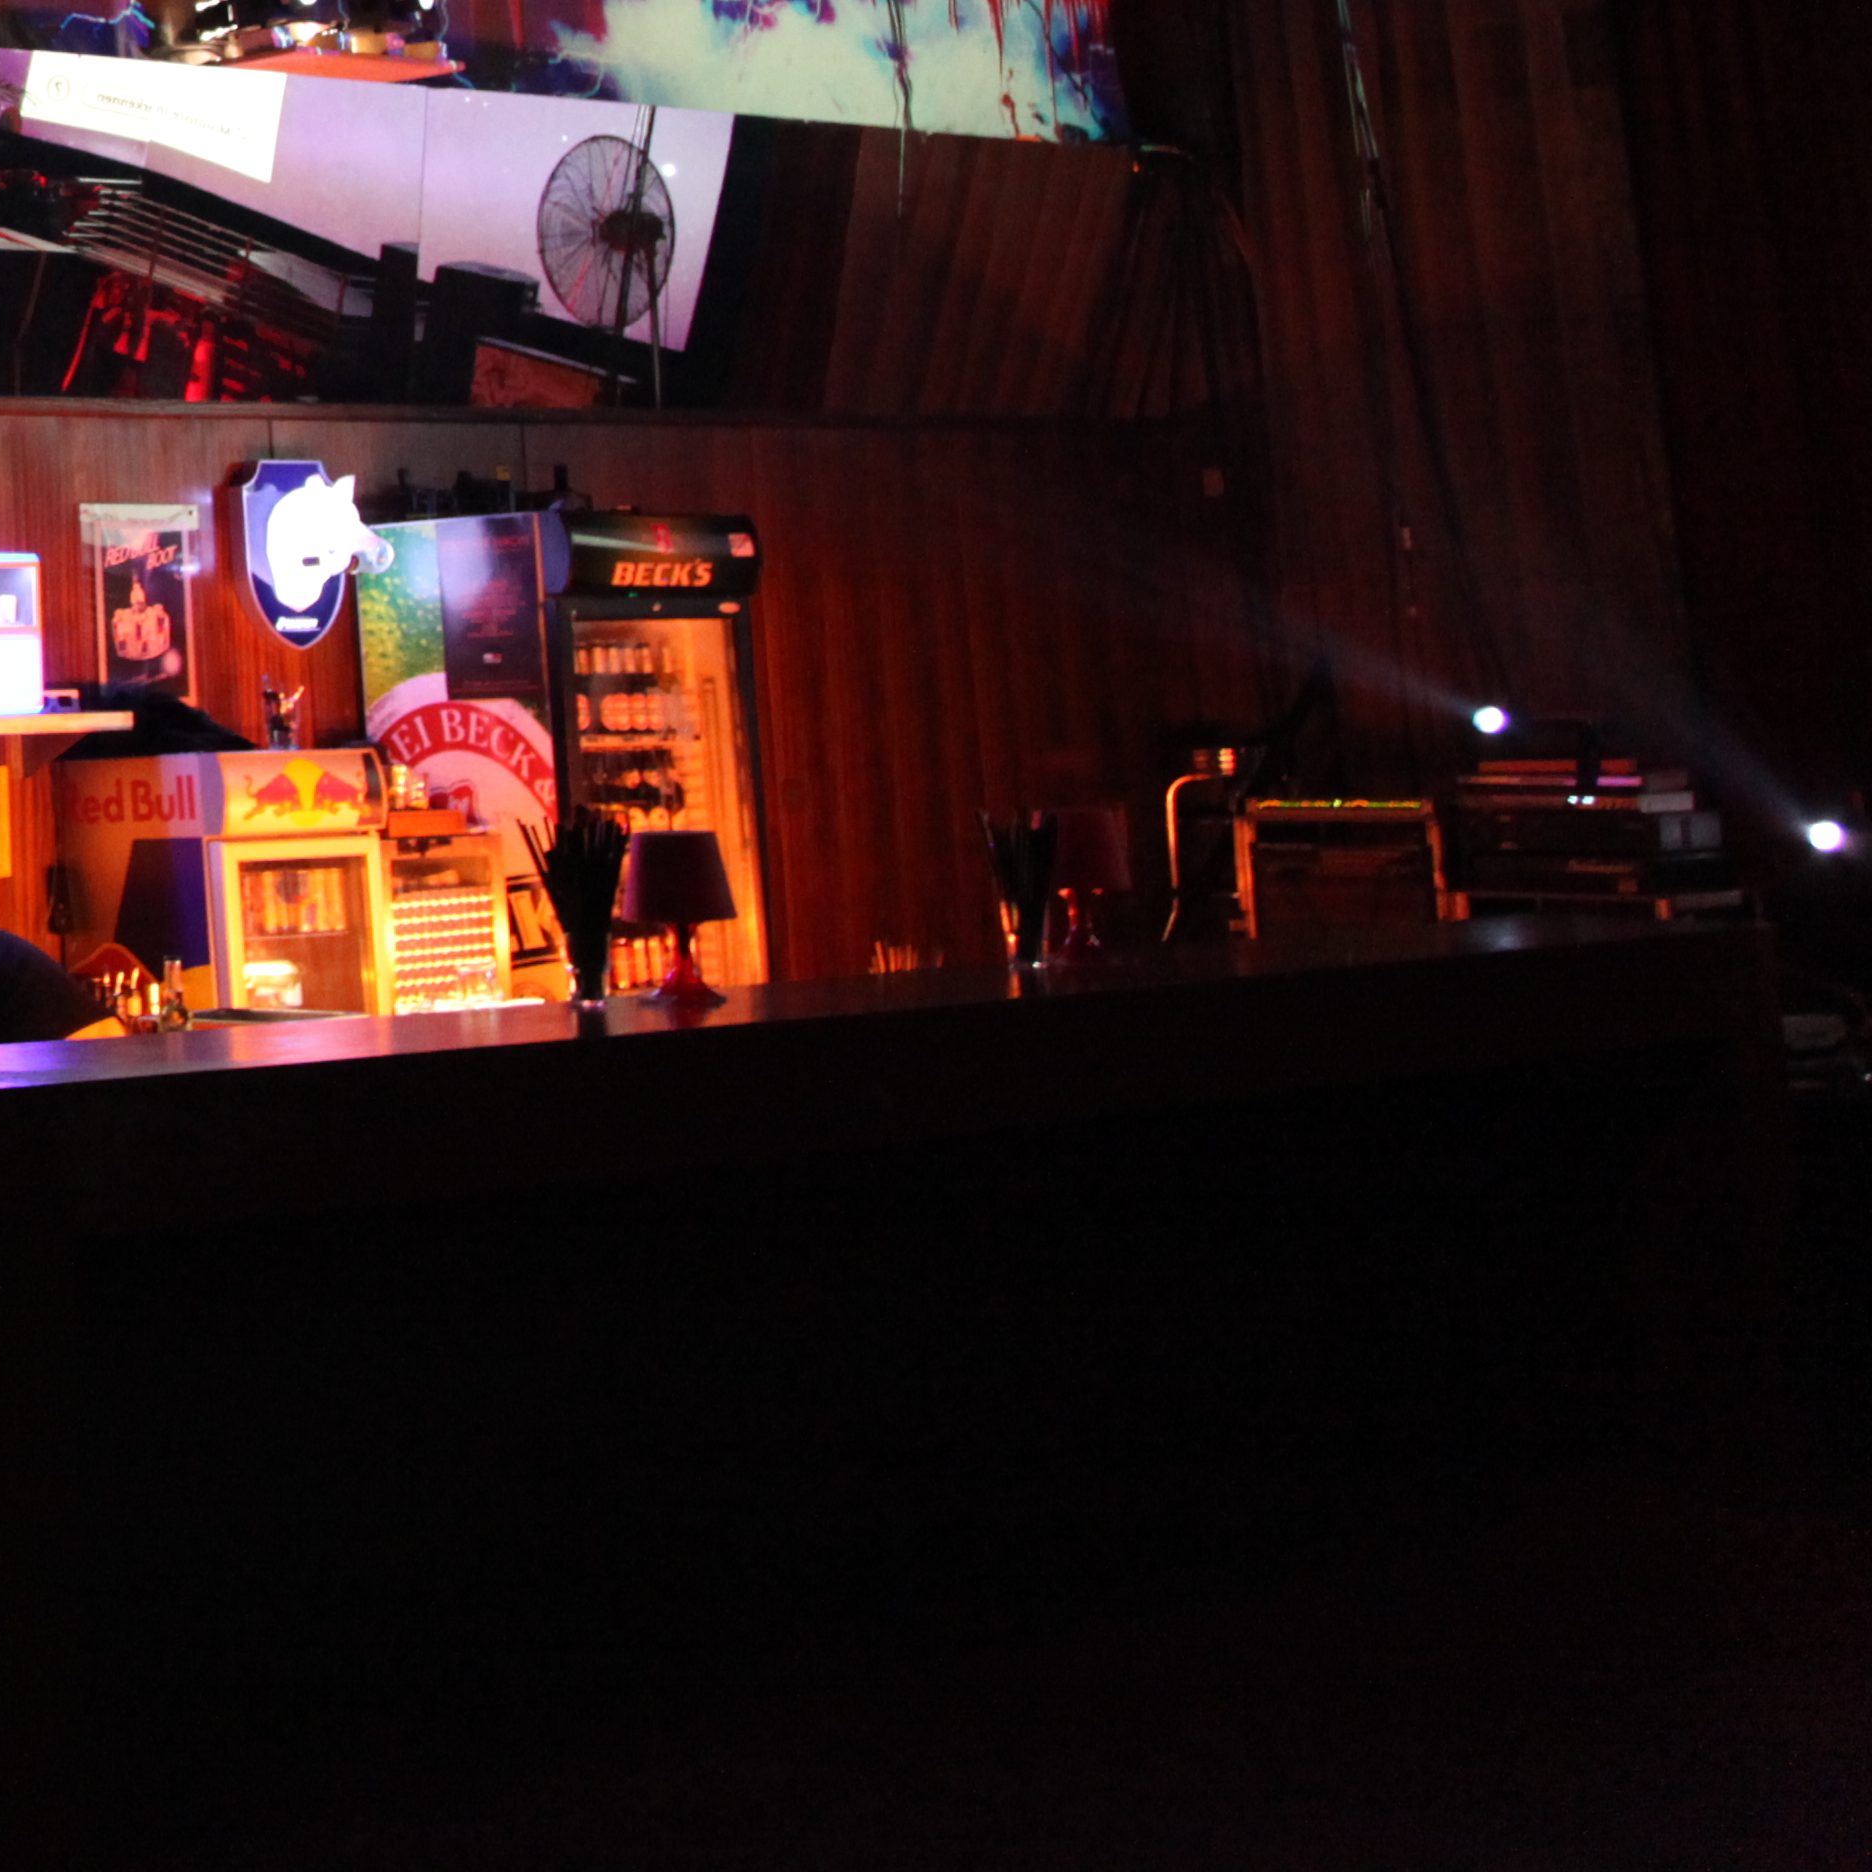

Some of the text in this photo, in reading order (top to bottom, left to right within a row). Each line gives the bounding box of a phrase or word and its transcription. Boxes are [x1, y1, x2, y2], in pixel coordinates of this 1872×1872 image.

[610, 559, 715, 588] BECK'S
[439, 708, 538, 780] BECK
[63, 774, 196, 825] Red Bull
